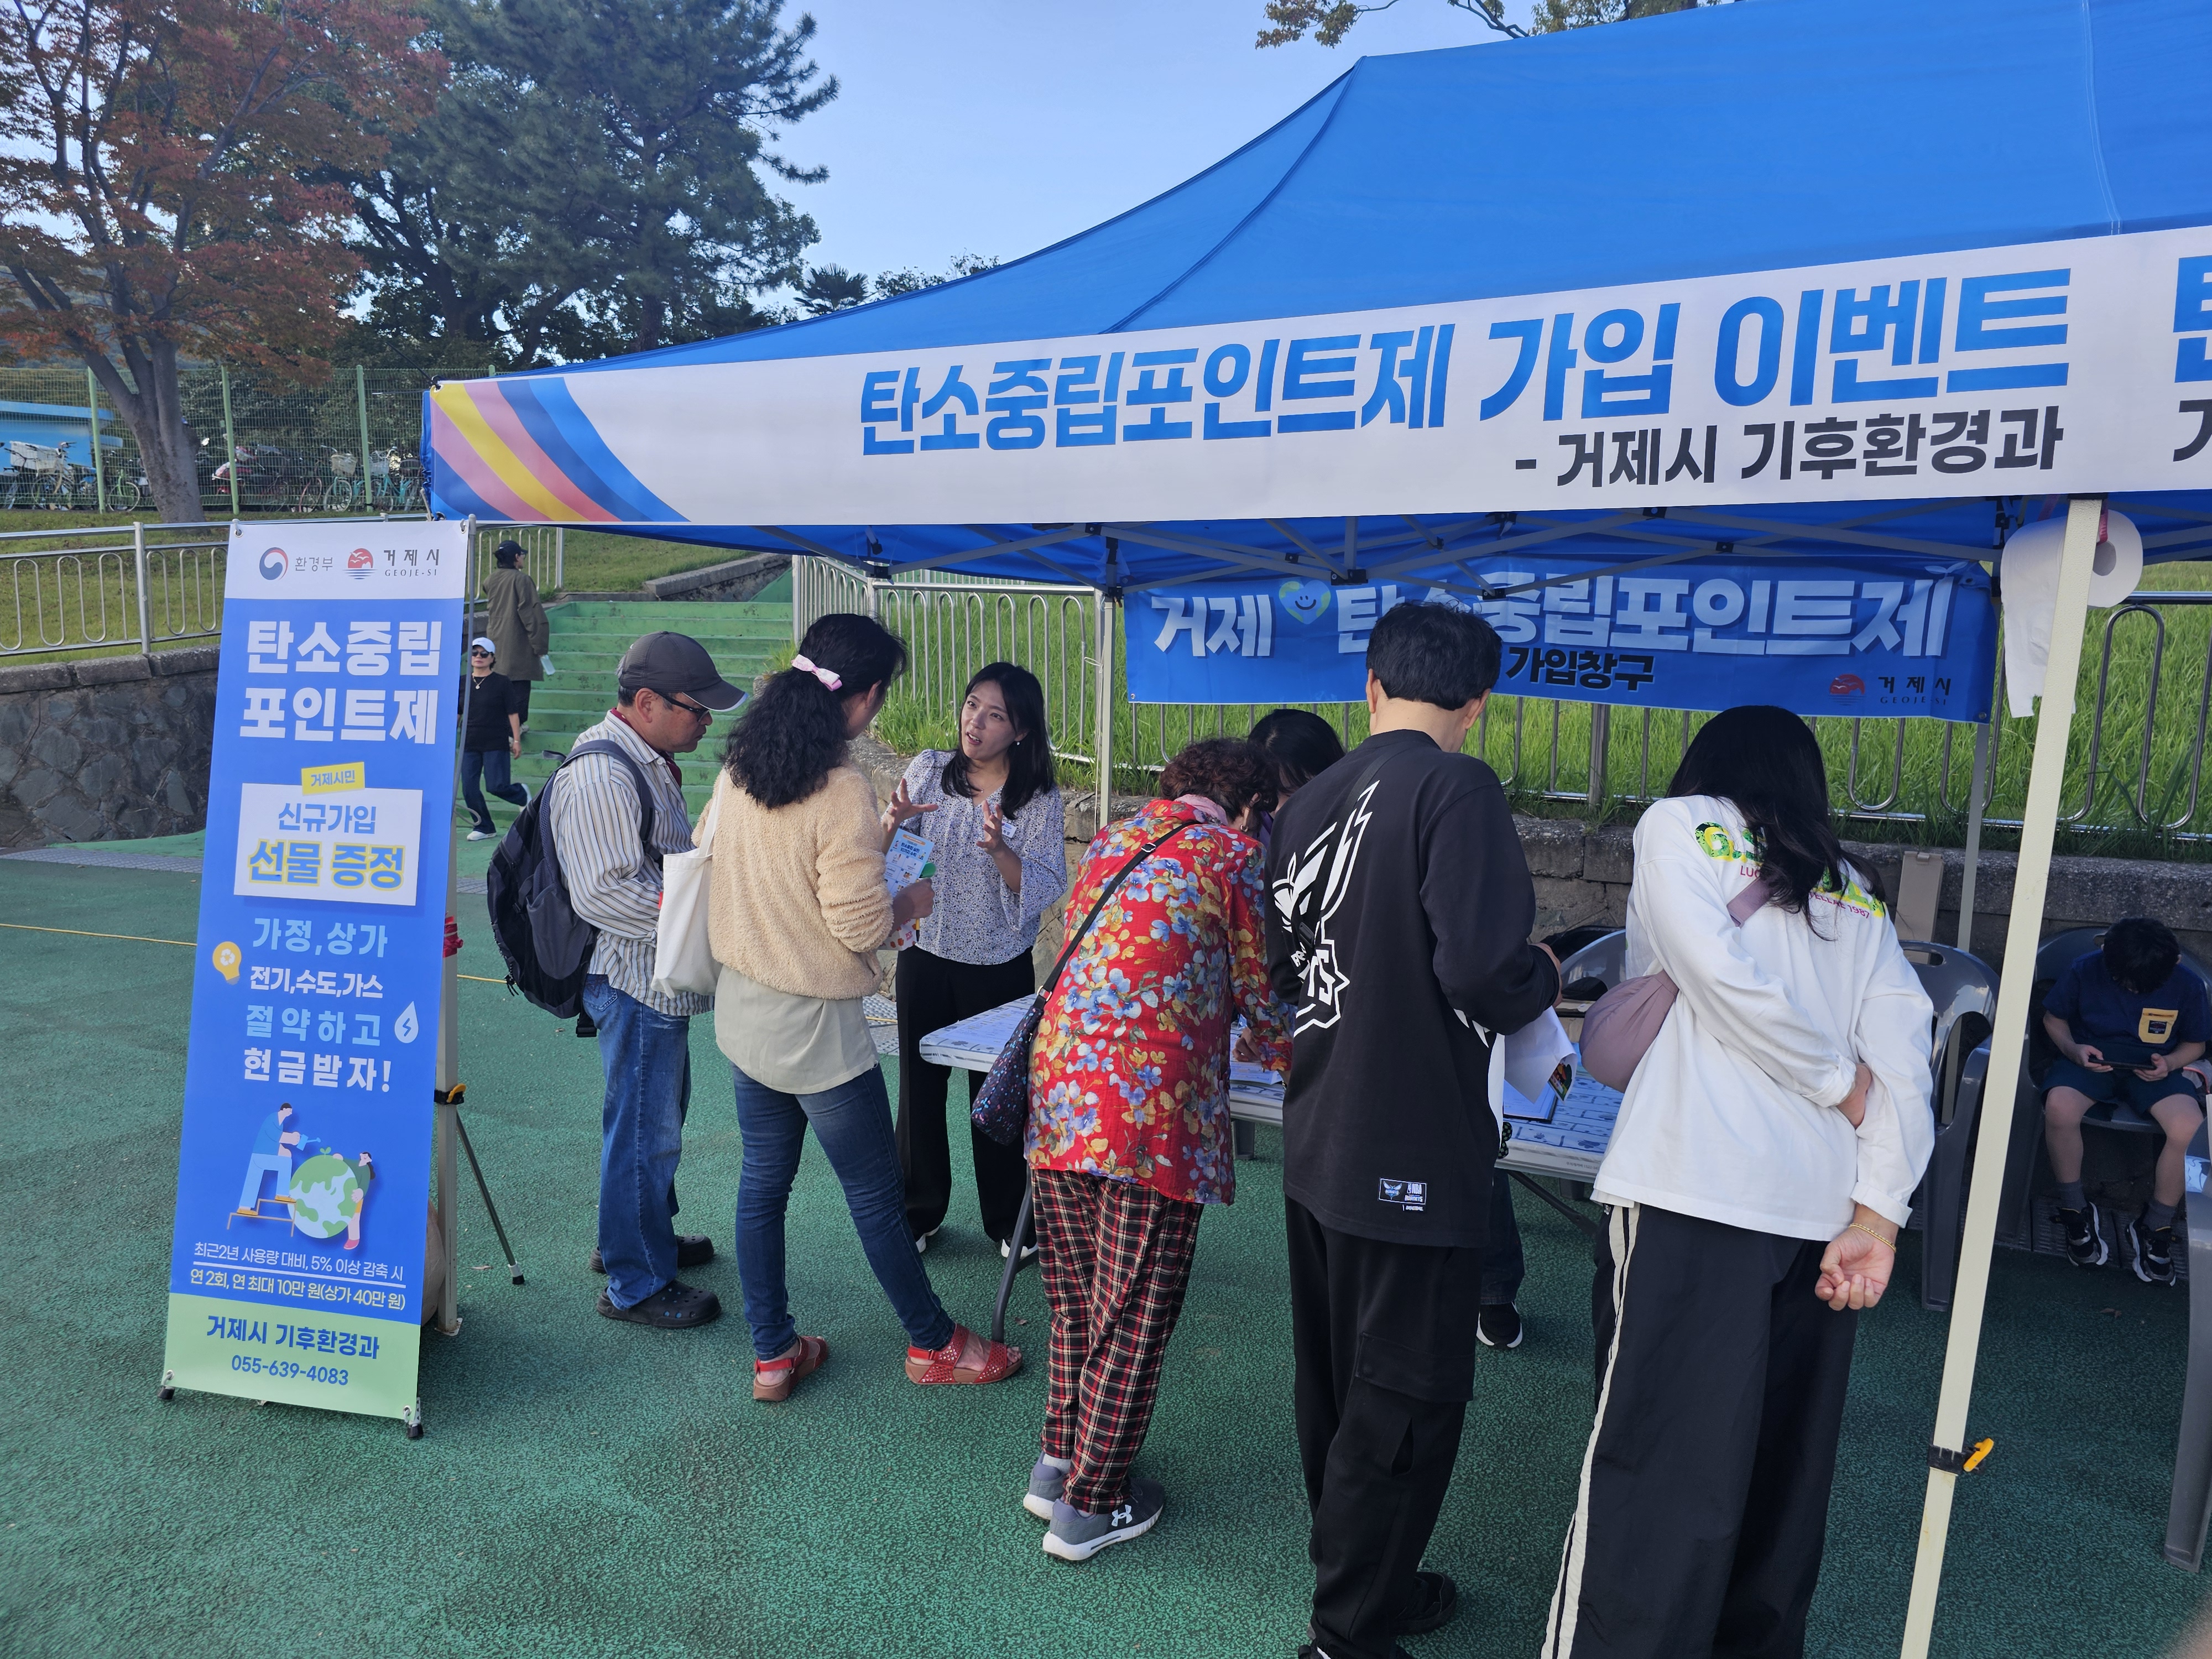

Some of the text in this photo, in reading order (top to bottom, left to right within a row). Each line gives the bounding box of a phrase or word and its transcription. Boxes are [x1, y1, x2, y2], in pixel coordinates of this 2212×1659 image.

[860, 323, 1455, 456] 탄소중립포인트제
[1480, 302, 1681, 422] 가입
[1714, 268, 2072, 408] 이벤트
[1557, 424, 1718, 488] 거제시
[1741, 405, 2064, 481] 기후환경과
[294, 556, 333, 572] 환경부
[383, 548, 440, 566] 거제시
[1151, 593, 1272, 658] 거제
[247, 620, 442, 676] 탄소중립
[1505, 646, 1655, 692] 가입창구
[1878, 676, 1952, 696] 거제시
[240, 687, 438, 744] 포인트제
[1880, 696, 1946, 706] GEOJE-SI
[310, 770, 356, 787] 거제시민
[278, 802, 377, 835] 신규가입
[247, 838, 405, 891] 선물 증정
[1849, 905, 1870, 919] 1987
[253, 917, 388, 958] 가정,상가
[250, 966, 383, 999] 전기,수도,가스
[246, 1004, 381, 1047] 절약하고
[243, 1047, 392, 1093] 현금받자!
[1411, 1183, 1422, 1194] NBA
[194, 1241, 404, 1281] 최근2년 사용량 대비, 5% 이상 감축 시
[190, 1269, 406, 1311] 연 2회, 연 최대 10만 원(상가 40만 원)
[206, 1314, 380, 1360] 거제시 기후환경과
[231, 1354, 349, 1387] 055-639-4083
